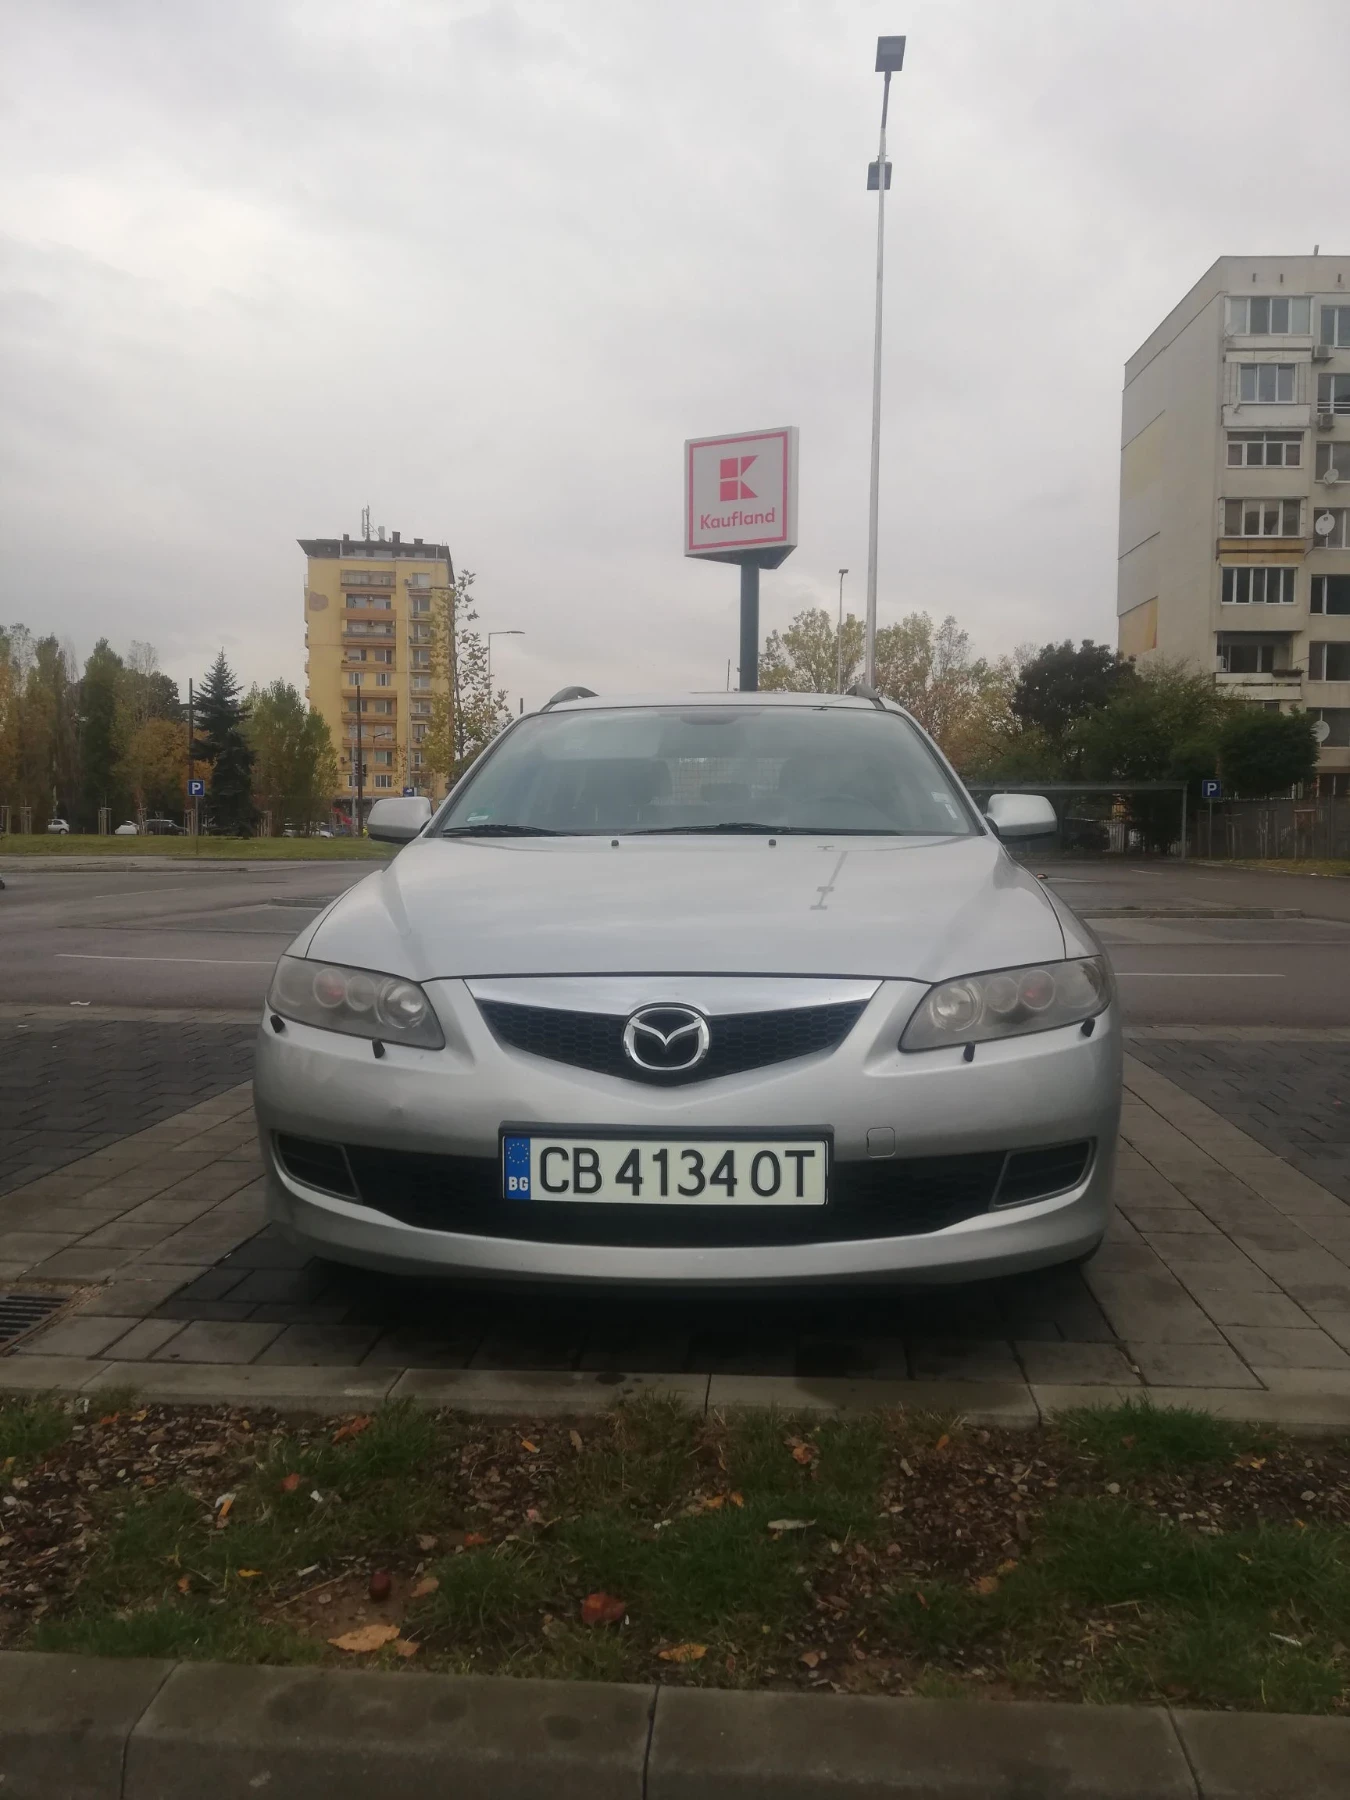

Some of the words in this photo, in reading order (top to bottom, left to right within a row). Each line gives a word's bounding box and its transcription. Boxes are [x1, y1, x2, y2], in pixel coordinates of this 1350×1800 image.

[700, 507, 775, 530] Kaufland
[191, 782, 201, 795] P
[1207, 782, 1217, 796] P
[540, 1146, 603, 1194] CB
[615, 1148, 738, 1198] 4134
[508, 1176, 529, 1191] BG
